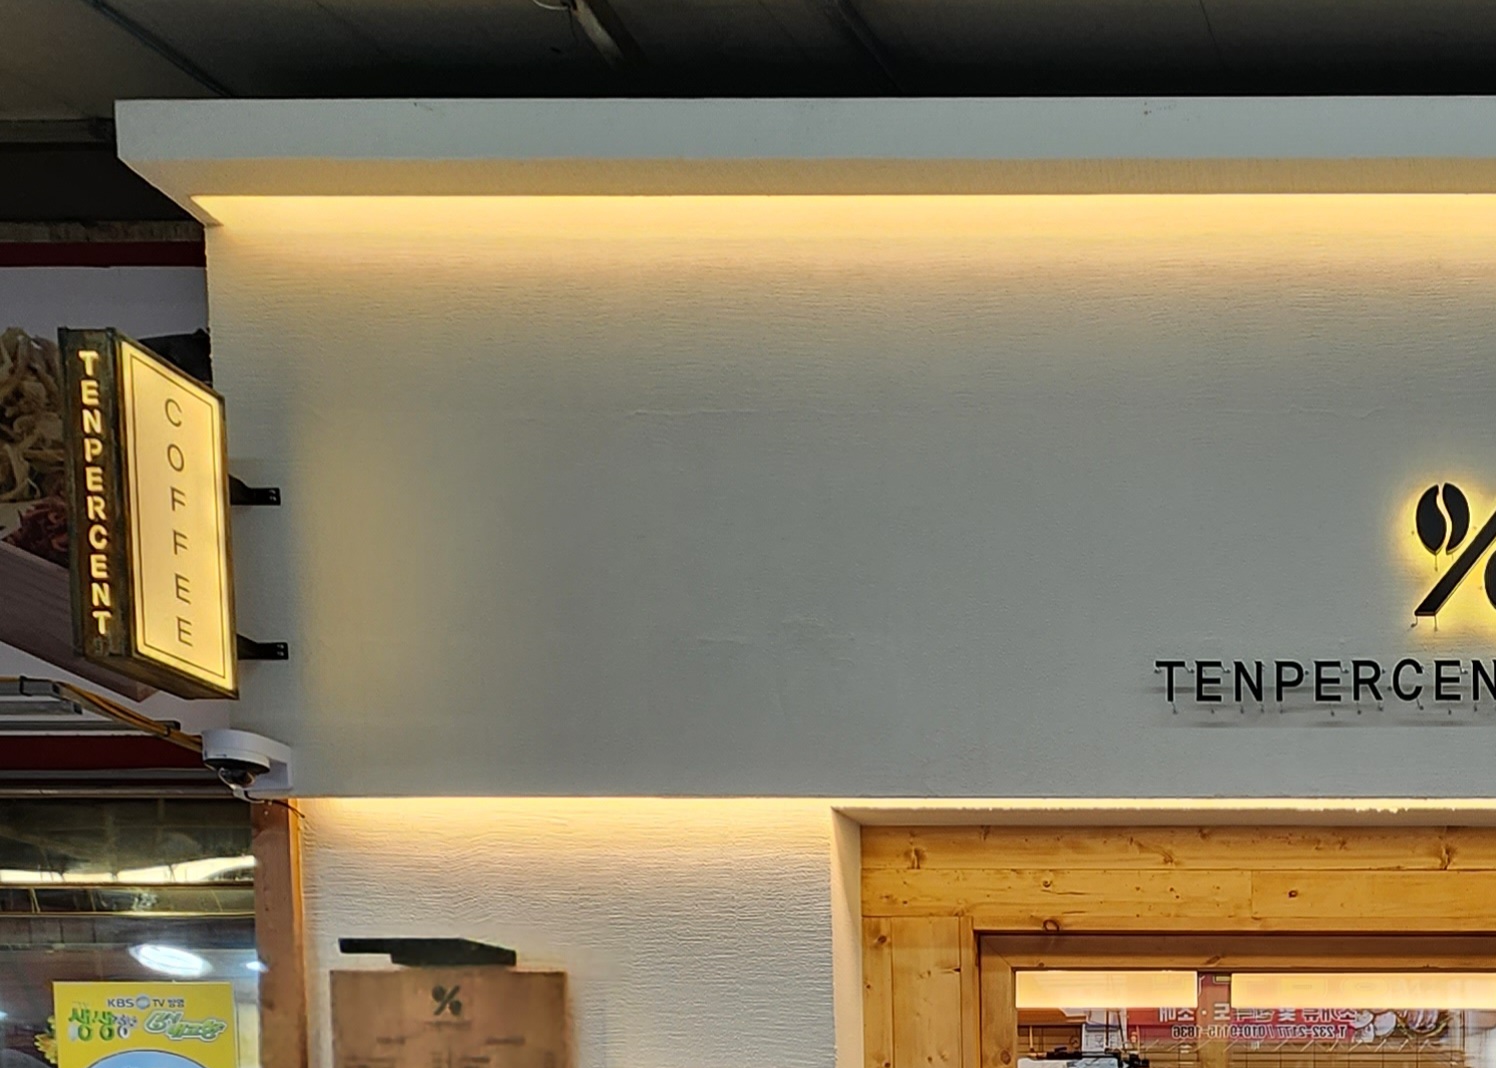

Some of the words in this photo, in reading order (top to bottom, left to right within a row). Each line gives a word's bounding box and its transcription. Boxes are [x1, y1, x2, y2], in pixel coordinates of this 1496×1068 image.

[77, 349, 113, 636] TENPERCENT
[163, 397, 194, 648] COFFEE
[107, 998, 135, 1008] KBS
[152, 998, 166, 1008] TV
